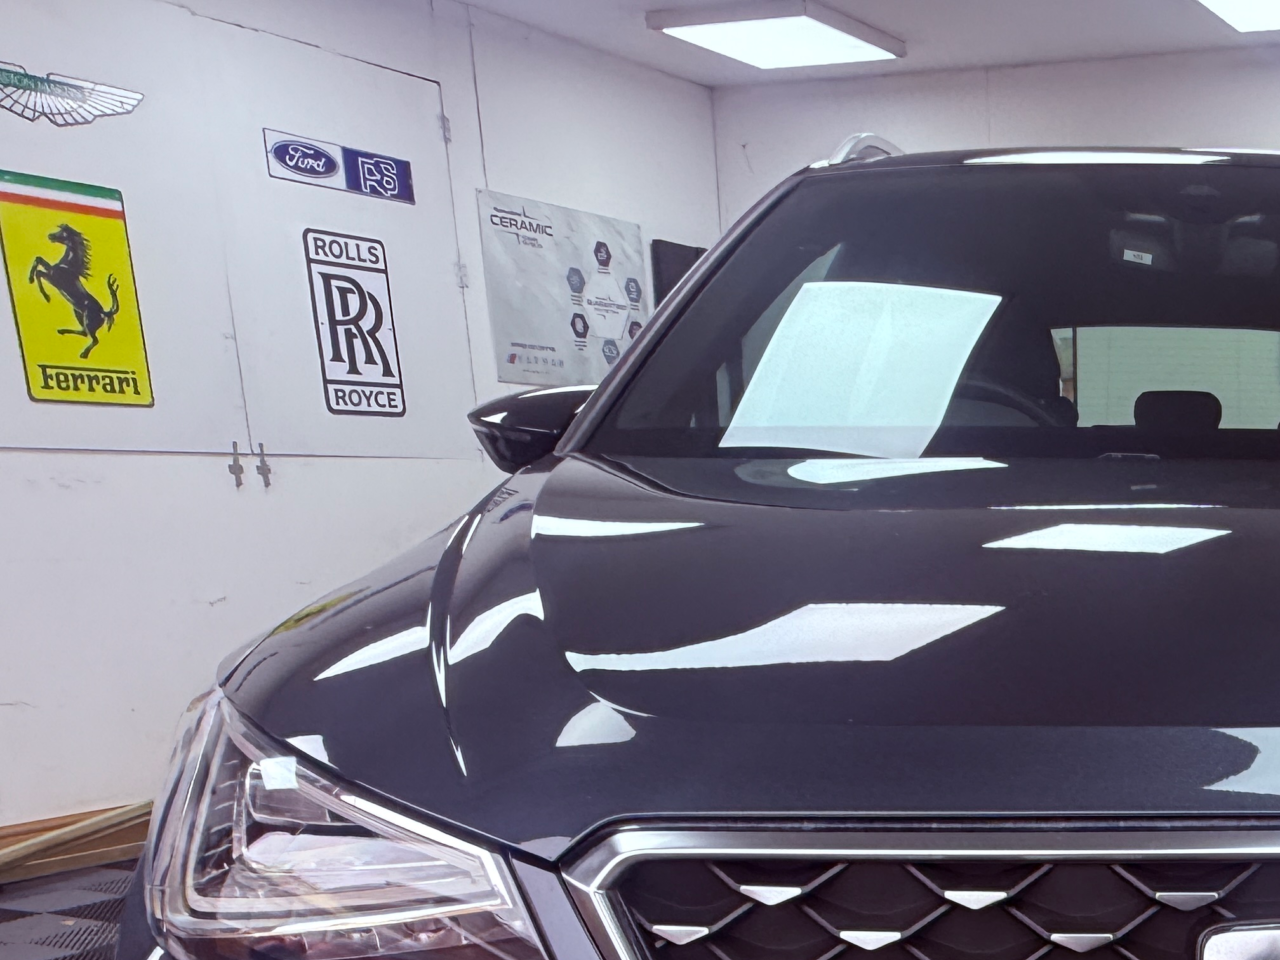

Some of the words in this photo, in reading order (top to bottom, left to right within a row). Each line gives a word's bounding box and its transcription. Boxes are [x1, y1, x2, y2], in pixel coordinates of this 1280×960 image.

[286, 146, 326, 172] Ford
[358, 157, 399, 196] RS
[490, 214, 553, 237] CERAMIC
[313, 237, 380, 265] ROLLS
[37, 364, 141, 395] Ferrari
[333, 388, 399, 408] ROYCE
